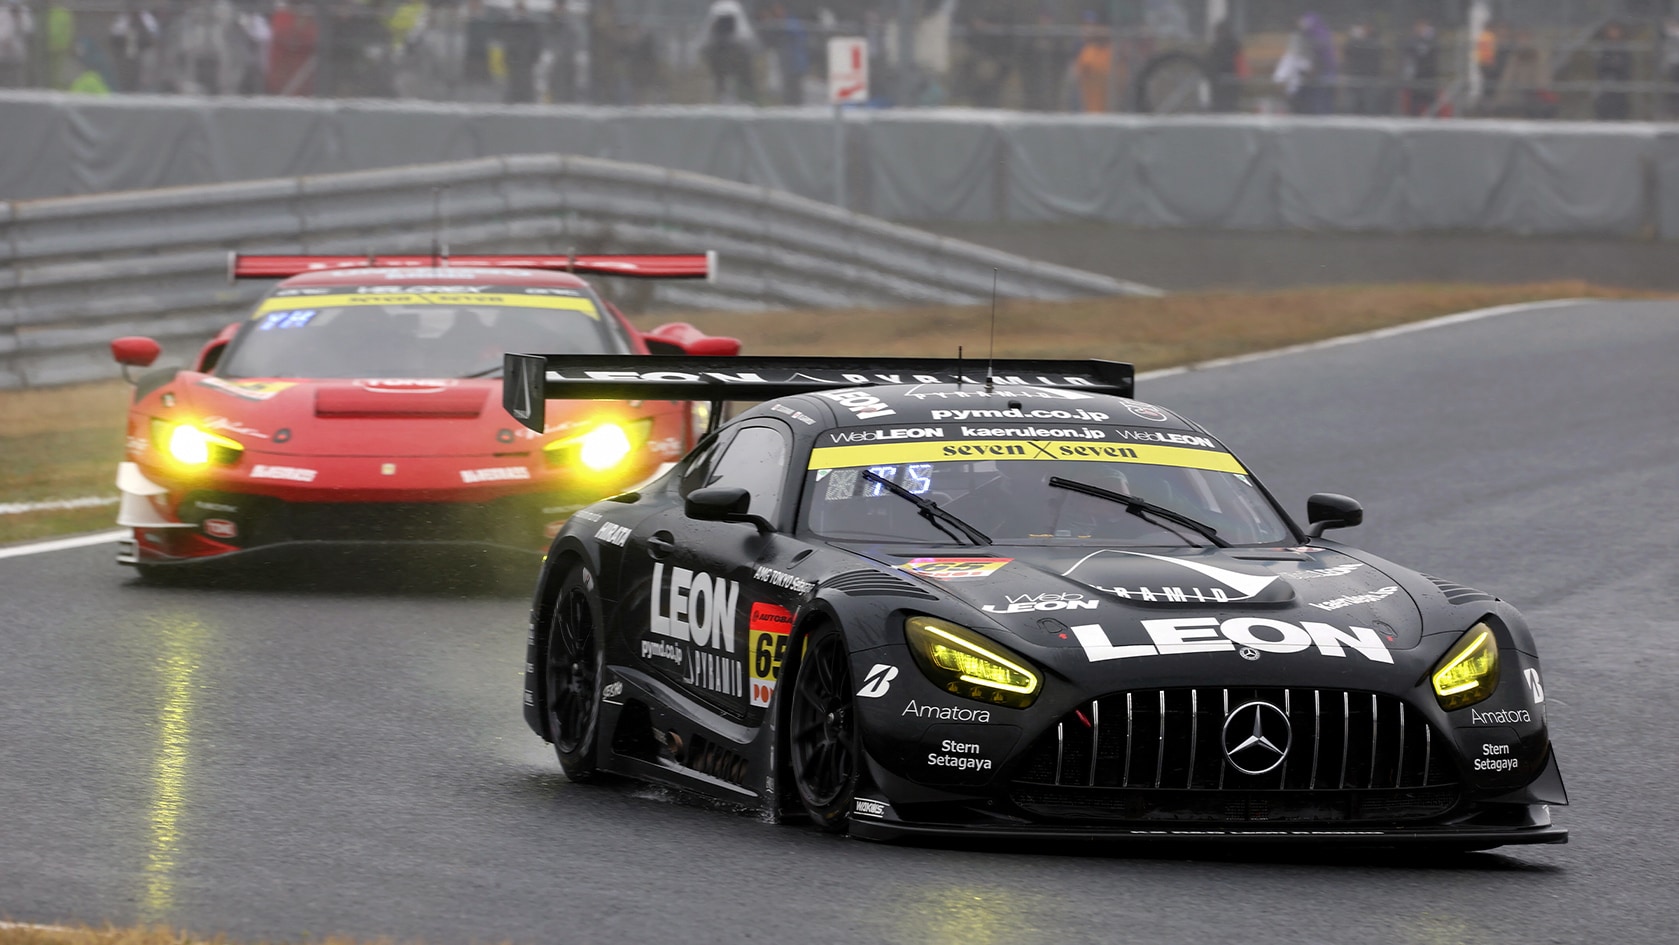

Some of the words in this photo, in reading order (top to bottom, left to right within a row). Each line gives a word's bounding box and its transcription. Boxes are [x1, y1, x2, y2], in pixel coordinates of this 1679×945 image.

[931, 408, 1109, 421] pymd.co.jp
[960, 426, 1106, 439] kaeruleon.jp
[942, 444, 1026, 456] seven
[1059, 444, 1139, 458] seven
[753, 566, 773, 582] AMG
[769, 570, 794, 589] TOKYO
[1005, 592, 1084, 603] Web
[1092, 586, 1230, 602] RAMID
[650, 562, 739, 653] LEON
[982, 599, 1099, 613] LEON
[1071, 617, 1394, 664] LEON
[694, 650, 742, 698] PYRAMID
[901, 700, 990, 723] Amatora
[1471, 708, 1531, 725] Amatora
[941, 740, 980, 754] Stern
[1482, 743, 1510, 755] Stern
[927, 753, 992, 771] Setagaya
[1474, 758, 1518, 771] Setagaya
